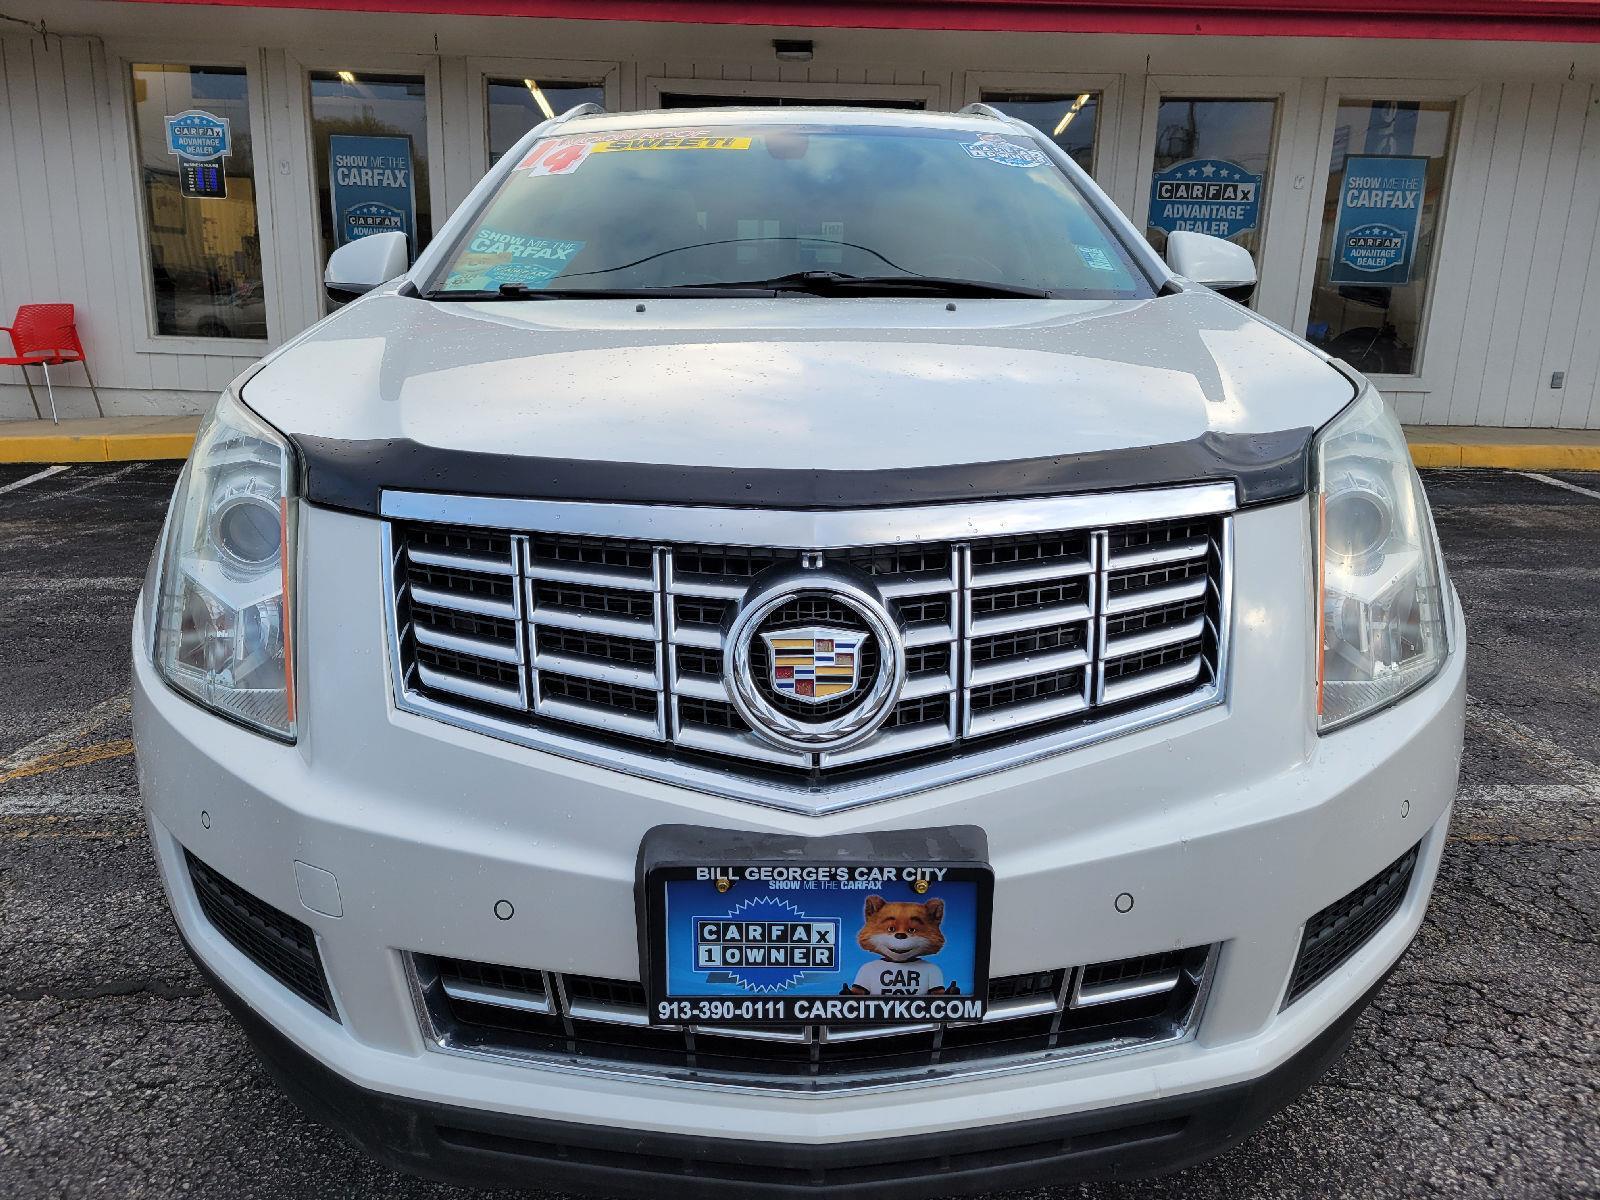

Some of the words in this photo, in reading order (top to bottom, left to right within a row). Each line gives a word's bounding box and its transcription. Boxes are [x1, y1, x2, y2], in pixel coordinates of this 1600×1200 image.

[174, 127, 222, 137] CARFAX
[178, 137, 220, 146] ADVANTAGE
[606, 137, 737, 150] SWEET!
[186, 146, 214, 154] DEALER
[517, 139, 588, 174] 14
[335, 155, 368, 167] SHOW
[370, 156, 386, 168] ME
[389, 156, 406, 169] THE
[336, 168, 407, 188] CARFAX
[1348, 176, 1381, 189] SHOW
[1382, 177, 1399, 189] ME
[1401, 178, 1420, 190] THE
[1160, 184, 1252, 201] CARFAX
[1346, 189, 1417, 209] CARFAX
[1163, 204, 1246, 220] ADVANTAGE
[349, 217, 400, 227] CARFAX
[1175, 220, 1230, 236] DEALER
[478, 229, 526, 245] SHOW
[526, 239, 548, 248] ME
[552, 242, 577, 250] THE
[1349, 238, 1401, 248] CARFAX
[470, 237, 576, 260] CARFAX
[1350, 249, 1396, 258] ADVANTAGE
[1356, 257, 1387, 266] DEALER
[696, 867, 741, 882] BILL
[744, 867, 850, 882] GEORGE'S
[852, 867, 898, 882] CAR
[902, 867, 948, 882] CITY
[768, 881, 801, 891] SHOW
[803, 881, 818, 890] ME
[820, 881, 839, 890] THE
[840, 881, 883, 890] CARFAX
[702, 925, 831, 944] CARFAX
[704, 948, 718, 964] 1
[725, 948, 834, 964] OWNER
[880, 970, 921, 987] CAR
[658, 1001, 785, 1020] 913-390-0111
[793, 1000, 983, 1020] CARCITYKC.COM
